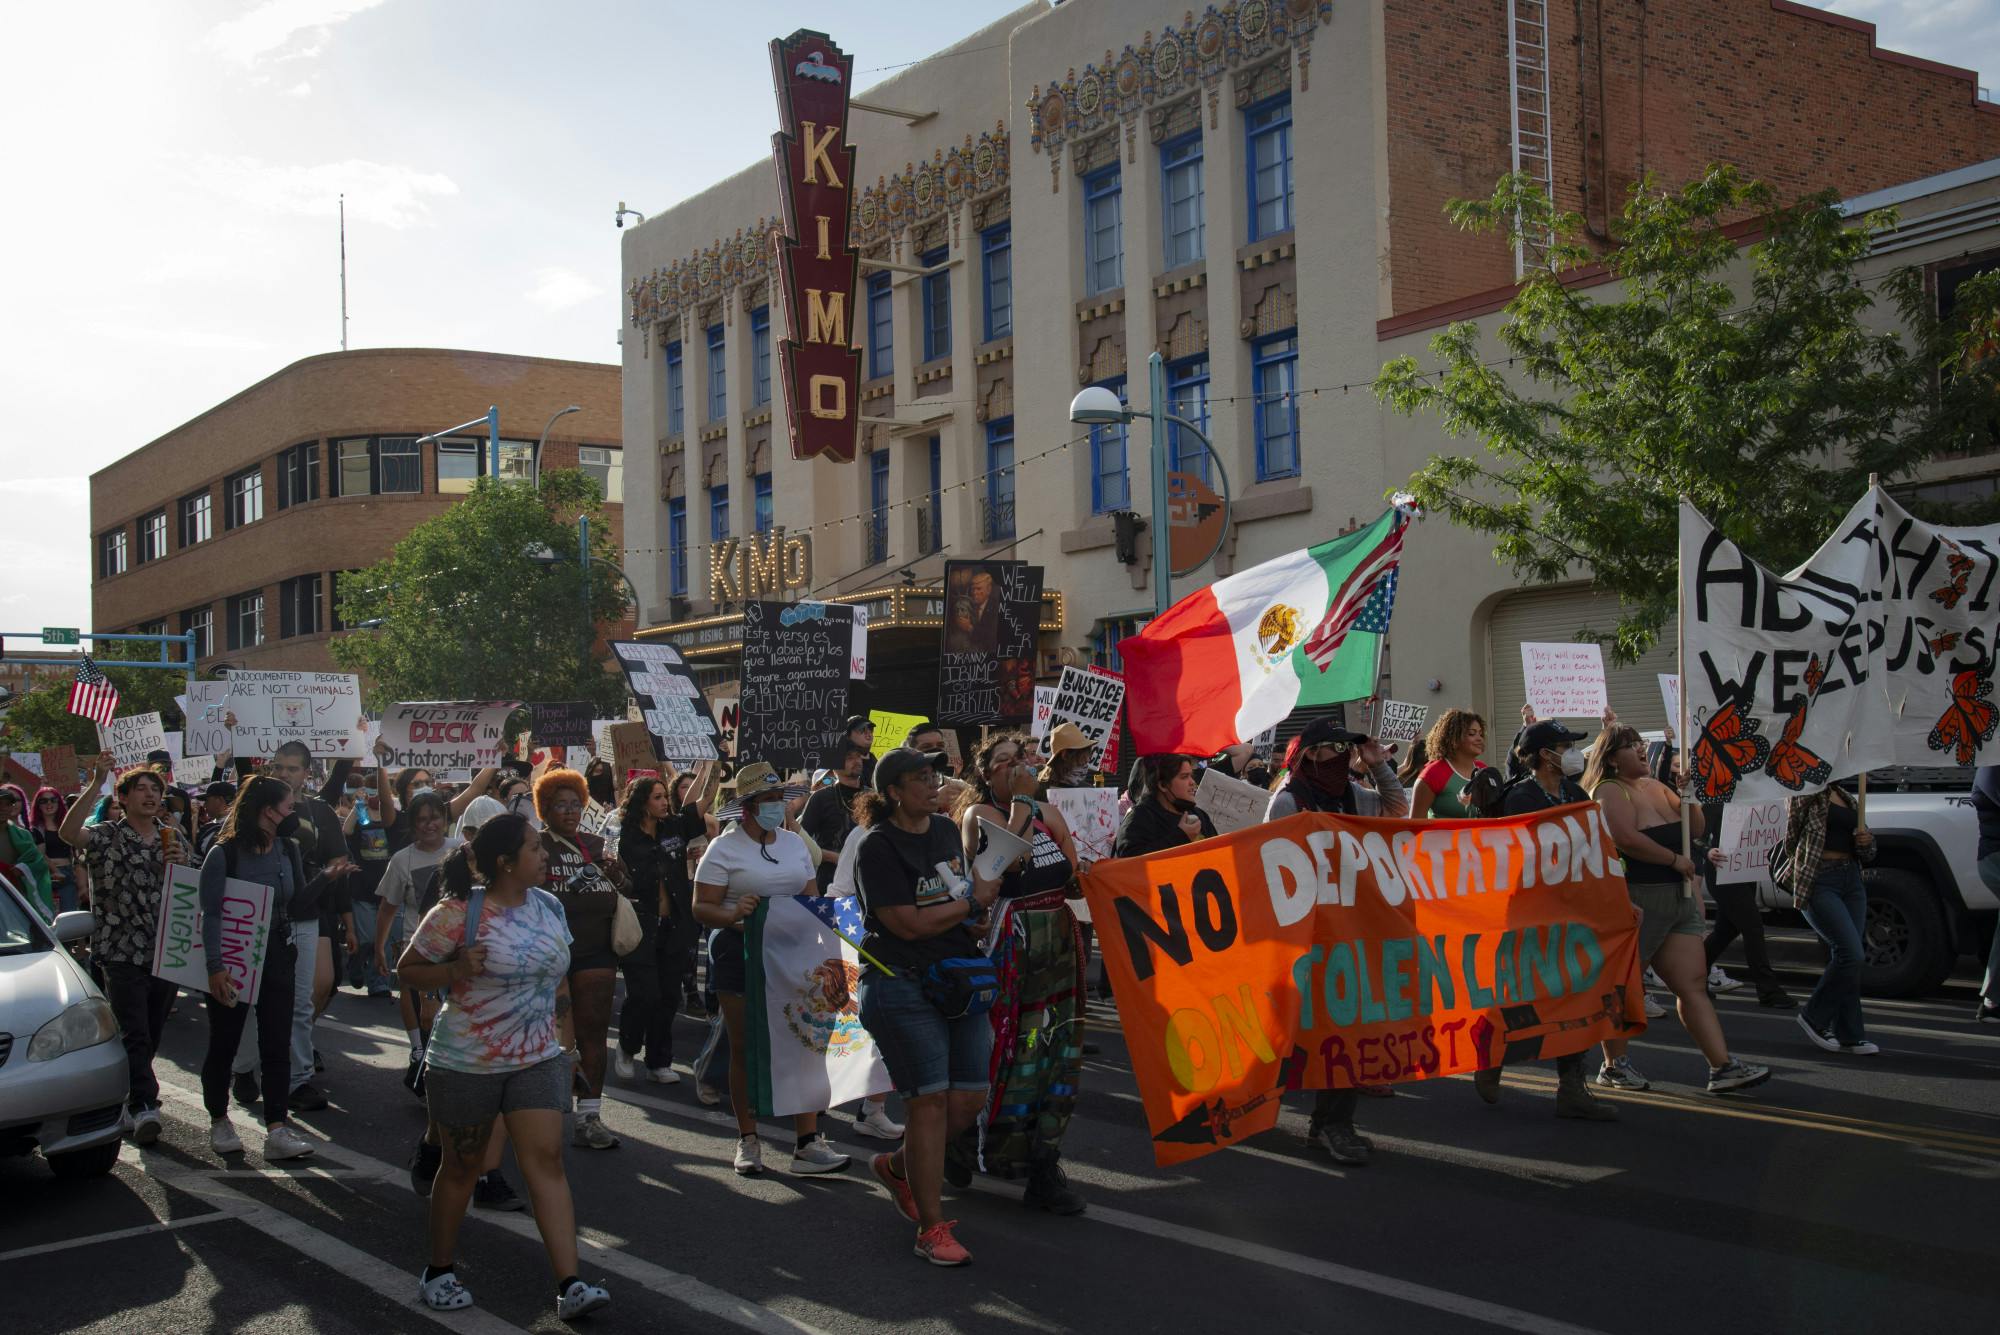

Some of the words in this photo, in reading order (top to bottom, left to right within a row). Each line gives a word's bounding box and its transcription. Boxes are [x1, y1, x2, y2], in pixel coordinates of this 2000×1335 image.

[801, 121, 846, 420] KIMO
[1002, 565, 1028, 588] WE
[882, 599, 891, 615] 12
[999, 602, 1032, 649] NEVER
[44, 628, 65, 643] 5th
[700, 627, 723, 643] RISING
[776, 630, 810, 642] verso
[813, 631, 830, 643] es
[777, 640, 815, 656] abuela
[828, 641, 844, 656] los
[997, 644, 1025, 658] LET
[744, 657, 765, 674] que
[771, 653, 802, 666] llevan
[228, 671, 302, 683] UNDOCUMENTED
[315, 674, 351, 683] PEOPLE
[787, 664, 840, 683] agarrados
[231, 683, 256, 697] ARE
[262, 684, 290, 695] NOT
[297, 685, 354, 696] CRIMINALS
[742, 684, 755, 697] de
[760, 683, 770, 695] la
[775, 680, 807, 693] mano
[1072, 674, 1124, 703] JUSTICE
[398, 708, 449, 720] PUTS
[455, 709, 480, 721] THE
[1054, 693, 1074, 712] NO
[1072, 695, 1118, 722] PEACE
[1384, 702, 1410, 719] KEEP
[1408, 706, 1427, 721] ICE
[113, 718, 134, 731] YOU
[136, 713, 157, 725] ARE
[754, 711, 800, 732] Todos
[806, 718, 817, 731] a
[1382, 717, 1400, 729] OUT
[1399, 720, 1411, 730] OF
[1408, 721, 1423, 731] MY
[113, 727, 145, 743] NOT
[237, 726, 258, 737] BUT
[262, 727, 272, 736] I
[279, 727, 306, 737] KNOW
[310, 728, 350, 737] SOMEONE
[409, 721, 476, 744] DICK
[113, 735, 161, 756] TRAGED
[116, 755, 129, 767] OU
[1749, 805, 1781, 828] NO
[1740, 827, 1781, 849] HUMAN
[1033, 851, 1067, 869] SAVAGE
[1729, 853, 1742, 873] IS
[1747, 848, 1769, 869] ILLE
[551, 866, 561, 877] IS
[1113, 868, 1238, 981] NO
[1166, 983, 1277, 1092] ON
[1462, 921, 1606, 1008] LAND
[1320, 1017, 1468, 1093] RESIST
